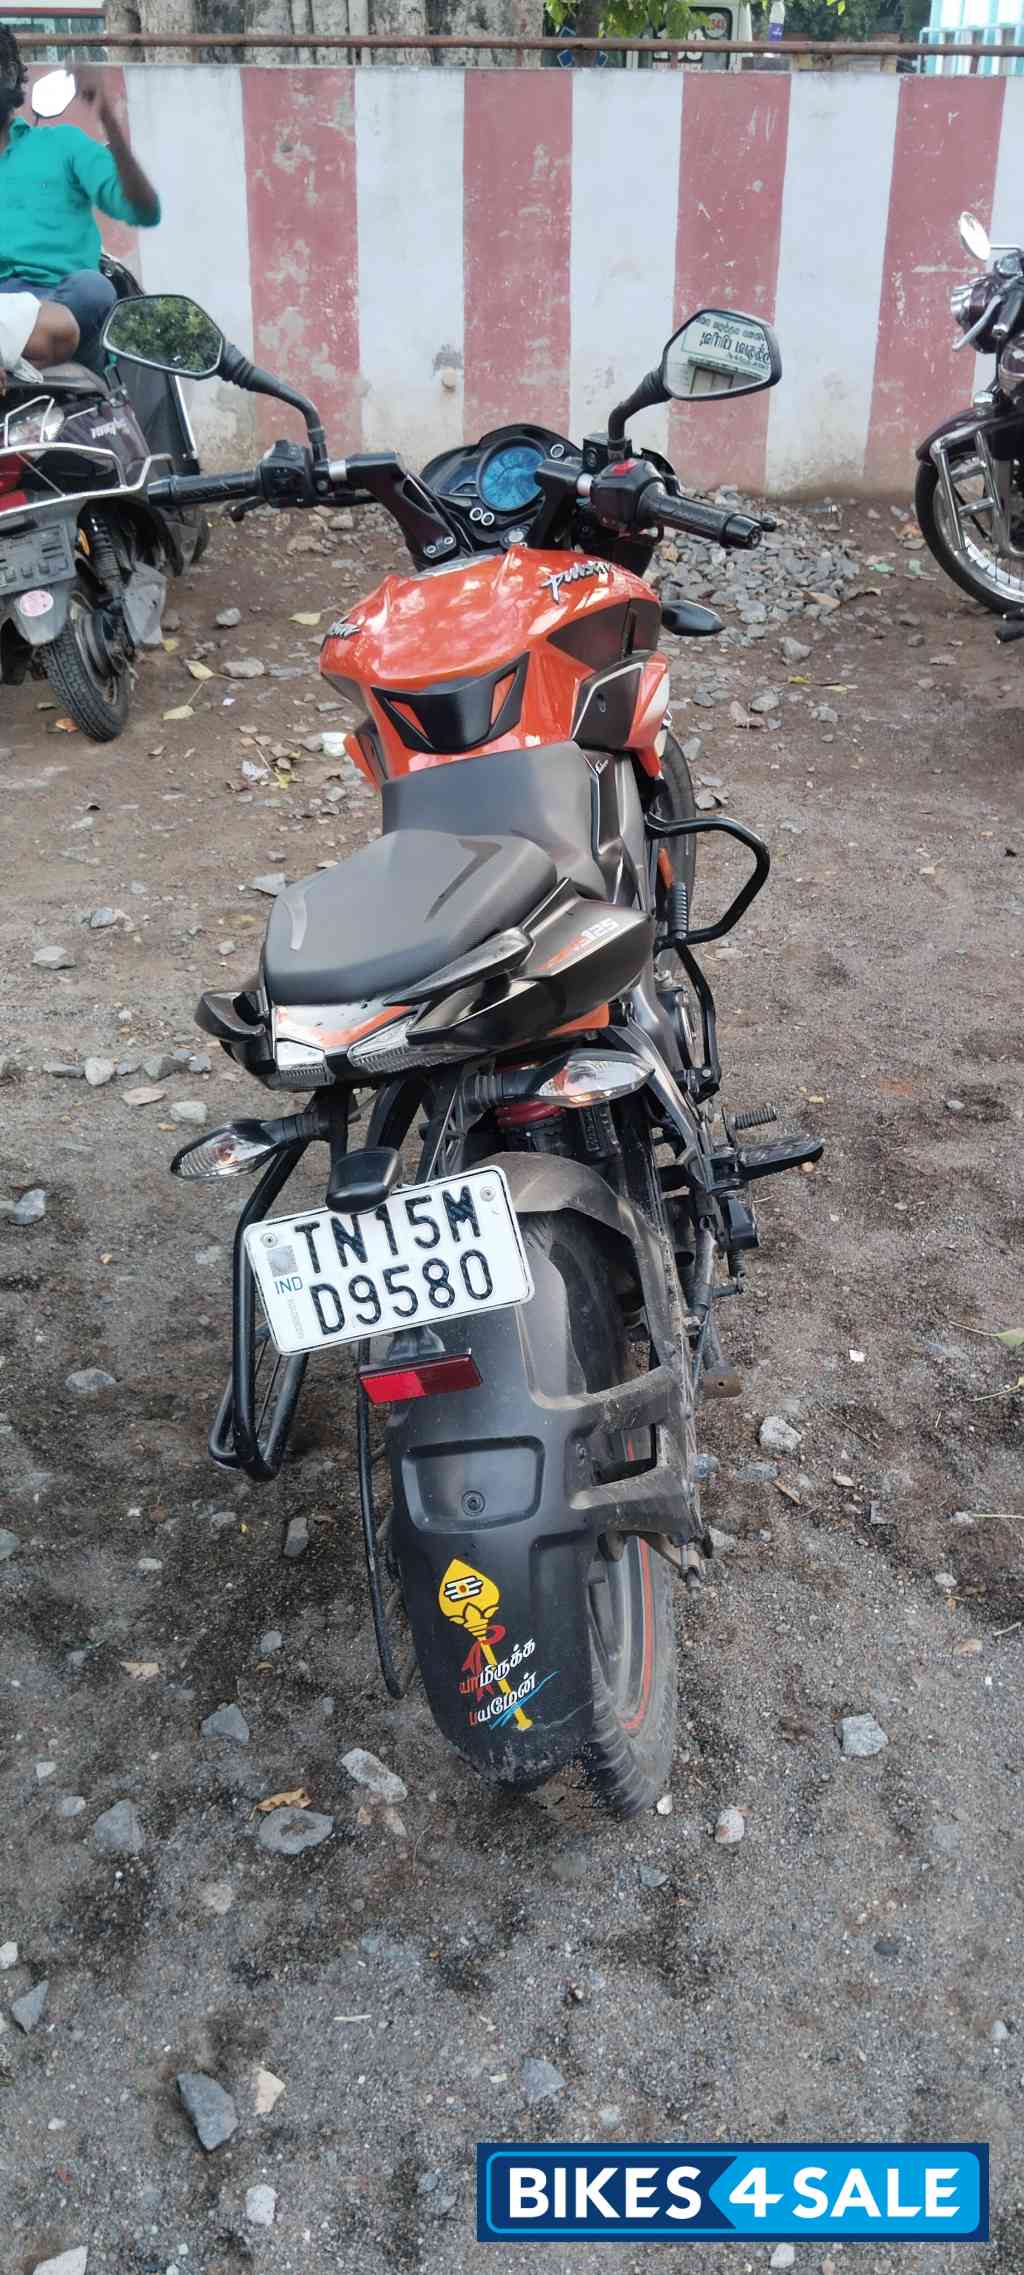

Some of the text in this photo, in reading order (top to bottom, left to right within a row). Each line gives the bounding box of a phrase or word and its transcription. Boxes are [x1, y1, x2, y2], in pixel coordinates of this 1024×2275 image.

[294, 1185, 481, 1274] TN15M
[273, 1276, 304, 1296] IND
[309, 1249, 494, 1336] D9580
[458, 1637, 536, 1694] யாமிருக்க
[469, 1671, 537, 1727] பயமேன்
